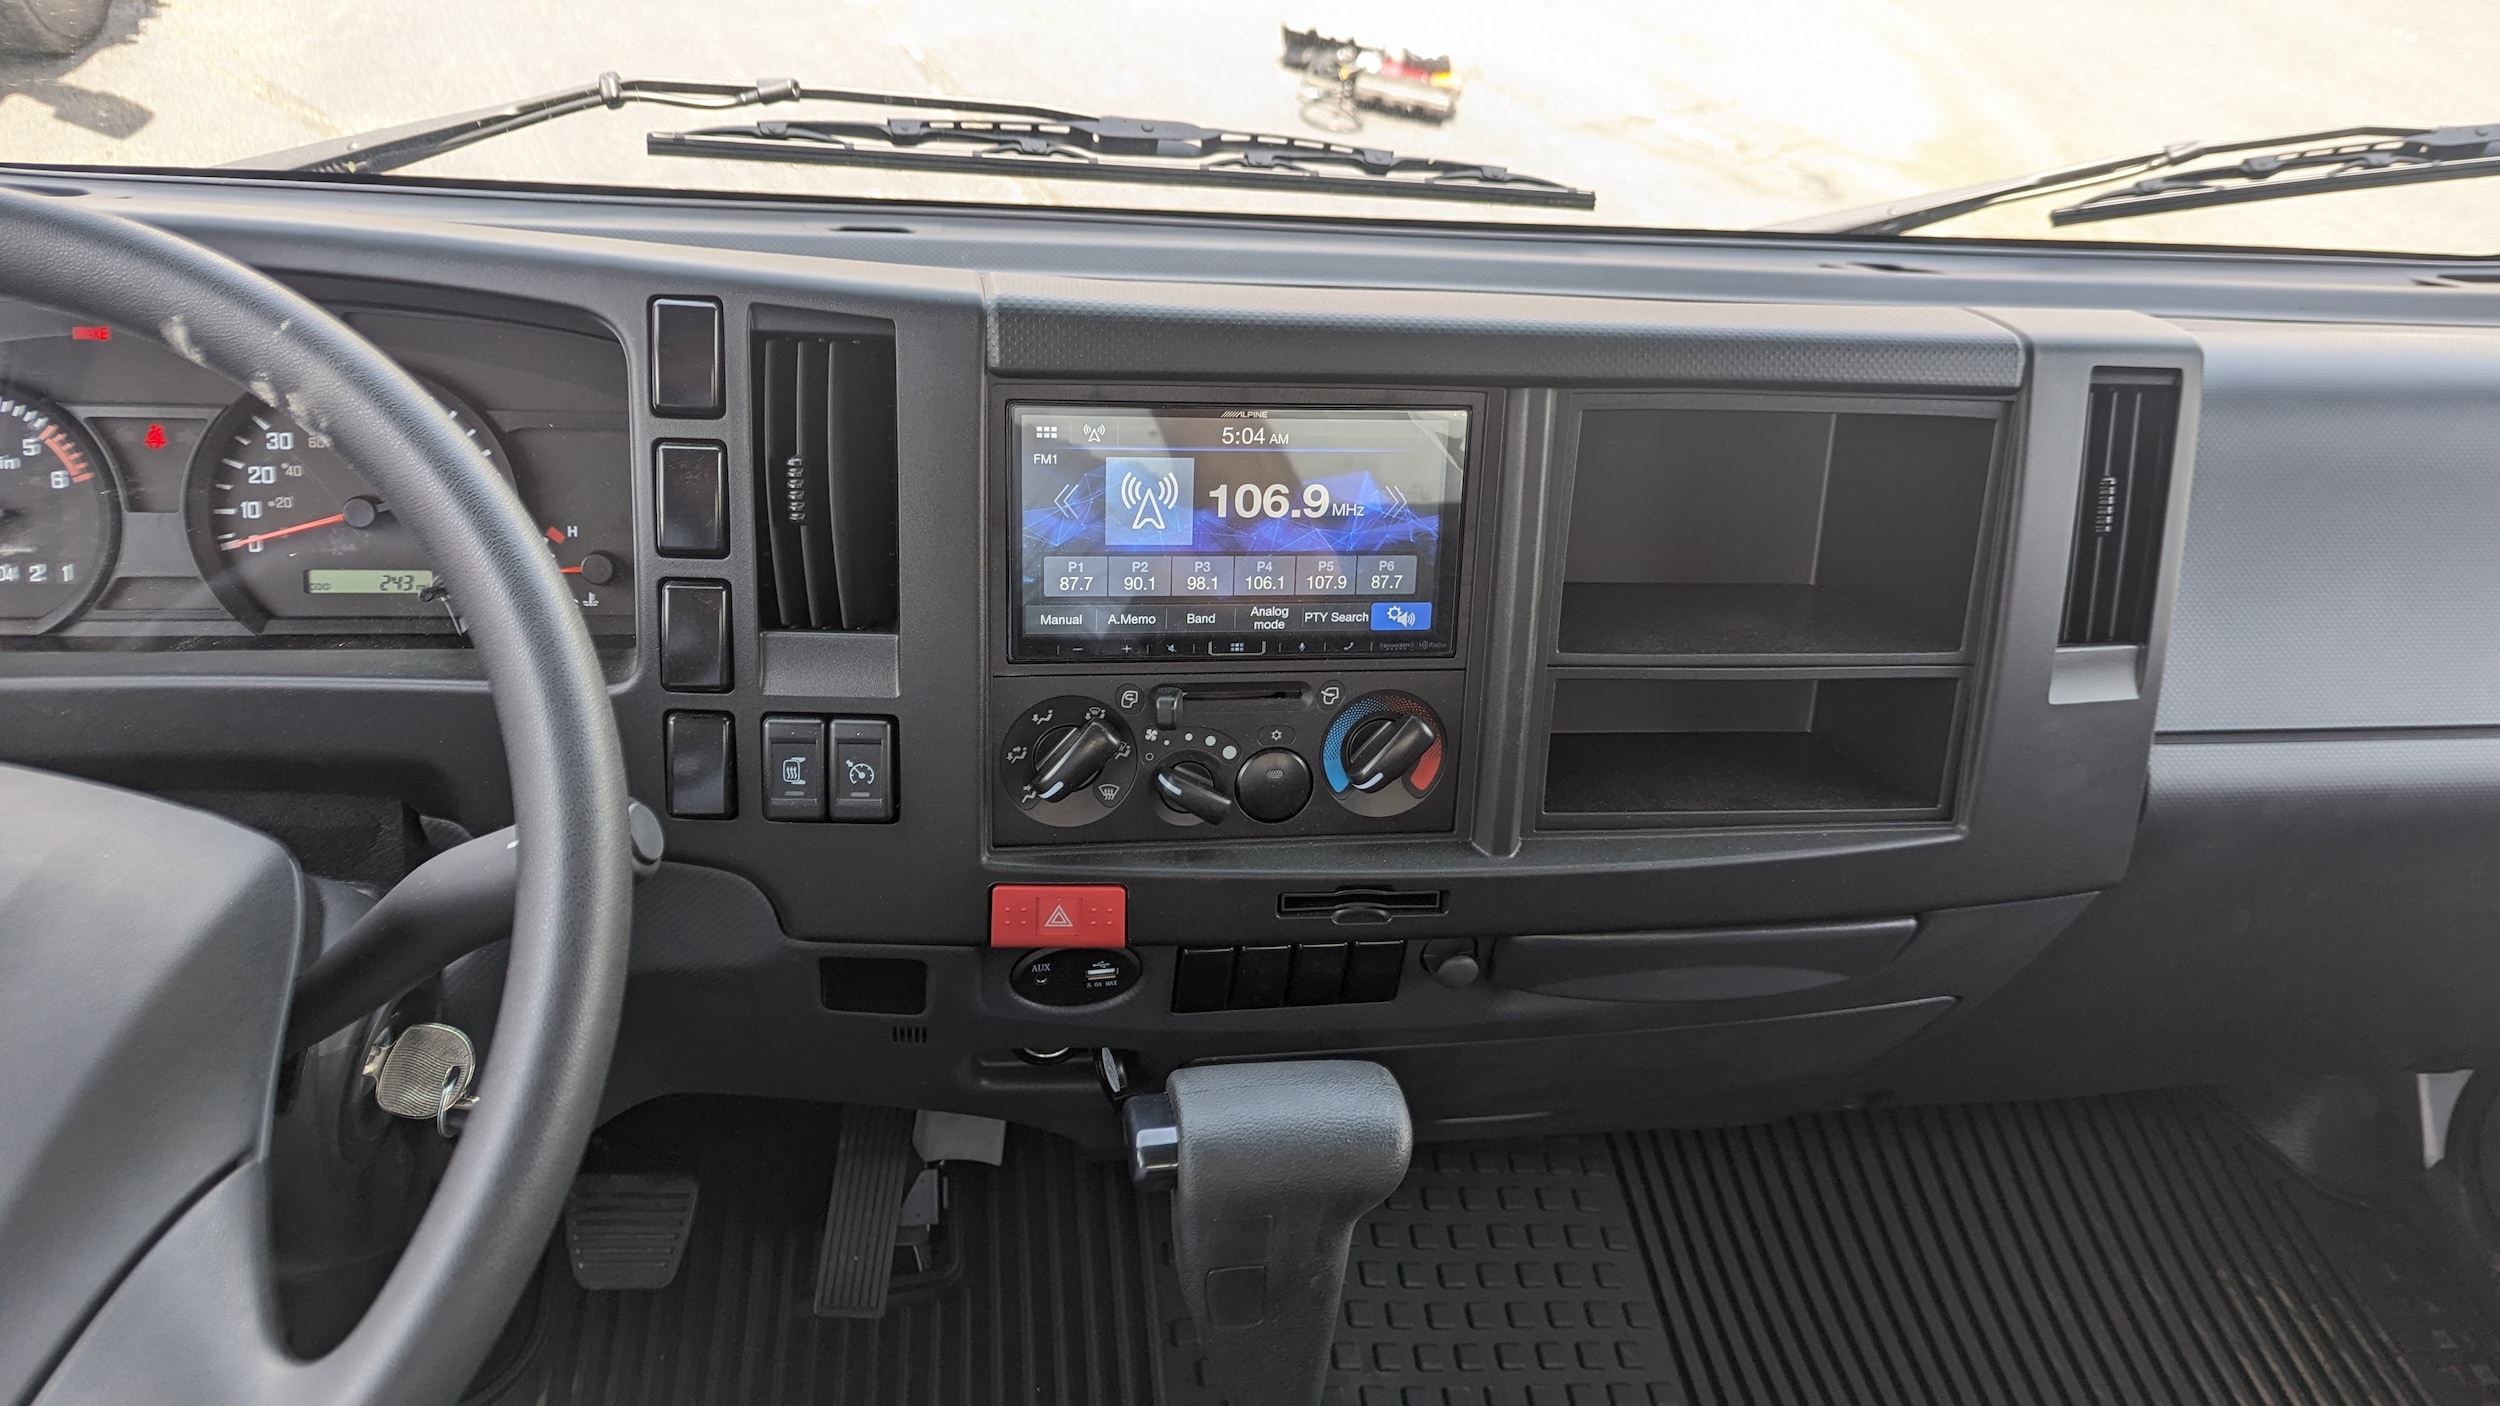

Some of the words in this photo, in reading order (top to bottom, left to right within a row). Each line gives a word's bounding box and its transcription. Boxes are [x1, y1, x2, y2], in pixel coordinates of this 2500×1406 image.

[1231, 411, 1268, 419] ALPINE
[265, 432, 293, 450] 30
[1222, 427, 1265, 445] 5:04
[1269, 434, 1289, 445] AM
[22, 438, 42, 456] 5
[1033, 453, 1058, 465] FM1
[247, 466, 275, 484] 20
[285, 465, 302, 477] 40
[50, 471, 70, 489] 6
[275, 497, 293, 508] 20
[1209, 483, 1330, 519] 106.9
[1332, 503, 1365, 517] MHz
[240, 501, 262, 519] 10
[567, 525, 578, 538] H
[61, 563, 74, 582] 1
[1068, 562, 1084, 573] P1
[1131, 561, 1149, 573] P2
[1194, 561, 1211, 573] P3
[1256, 561, 1273, 572] P4
[1318, 561, 1334, 572] P5
[1378, 560, 1395, 572] P6
[29, 564, 47, 582] 2
[379, 575, 414, 591] 243
[1059, 576, 1094, 591] 87.7
[1123, 577, 1156, 591] 90.1
[1186, 576, 1219, 591] 98.1
[1245, 576, 1284, 590] 106.1
[1306, 576, 1347, 590] 107.9
[1370, 575, 1403, 590] 87.7
[1187, 613, 1216, 624] Band
[1250, 606, 1289, 619] Analog
[1304, 613, 1328, 623] PTY
[1331, 612, 1369, 623] Search
[1040, 614, 1083, 626] Manual
[1108, 614, 1157, 625] A.Memo
[1254, 619, 1285, 631] mode
[1031, 963, 1051, 973] AUX
